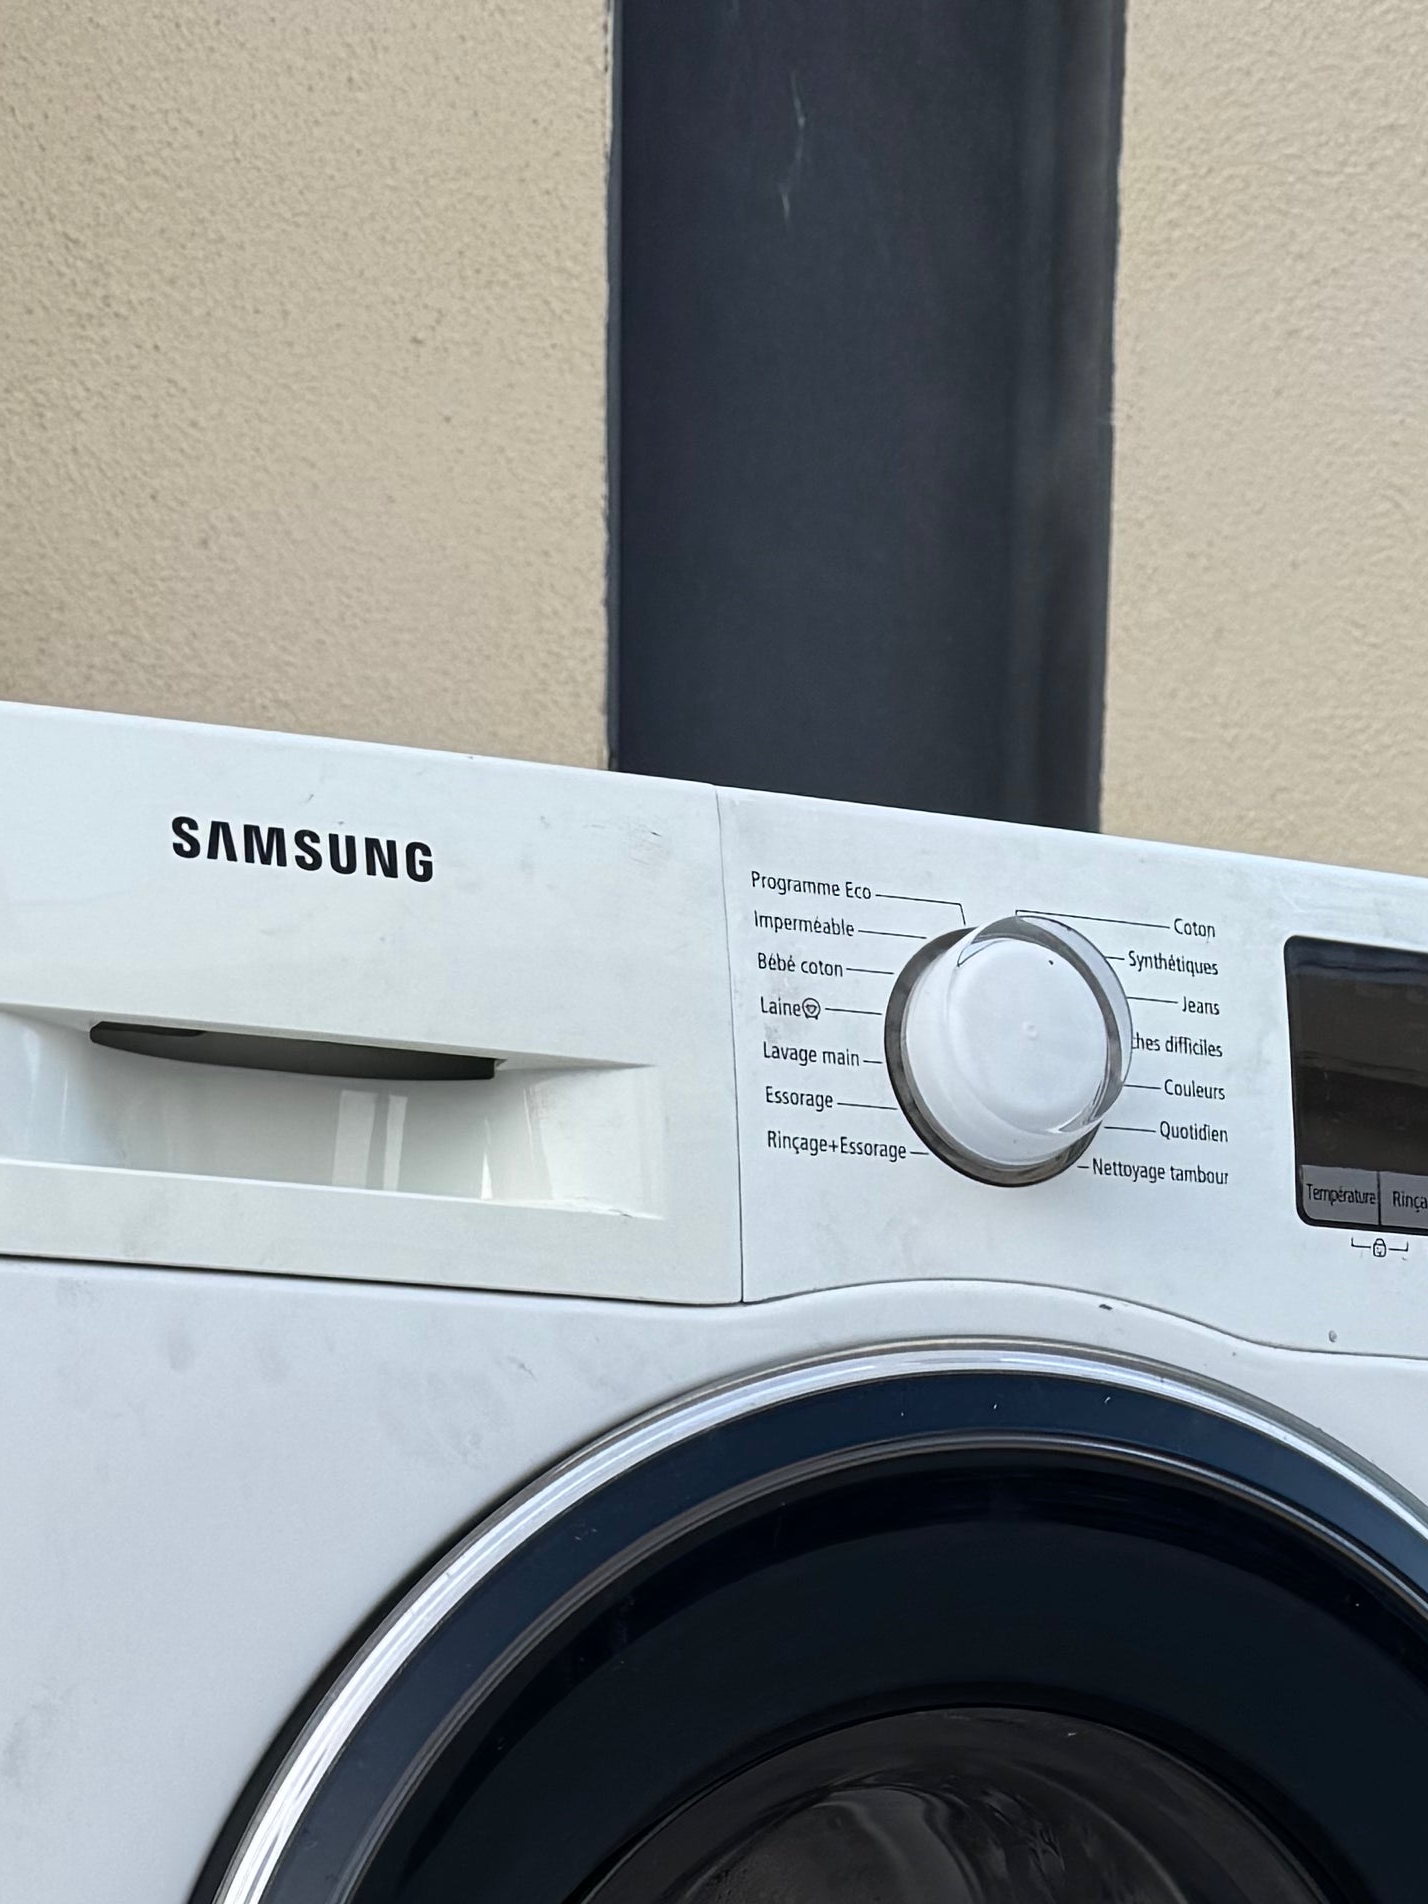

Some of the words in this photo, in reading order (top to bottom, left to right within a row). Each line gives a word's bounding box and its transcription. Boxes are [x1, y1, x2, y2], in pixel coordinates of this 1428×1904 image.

[172, 815, 434, 883] SAMSUNG
[751, 871, 841, 899] Programme
[845, 881, 872, 900] Eco
[754, 911, 854, 938] Imperméable
[1174, 919, 1215, 940] Coton
[757, 952, 796, 974] Bébé
[802, 959, 843, 978] coton
[1128, 950, 1219, 976] Synthétiques
[760, 997, 802, 1017] Laine
[1182, 997, 1220, 1016] Jeans
[763, 1042, 817, 1066] Lavage
[822, 1049, 860, 1067] main
[1166, 1036, 1223, 1057] difficiles
[766, 1087, 834, 1111] Essorage
[1164, 1079, 1226, 1100] Couleurs
[1159, 1122, 1228, 1143] Quotidien
[767, 1130, 907, 1162] Rinçage+Essorage
[1093, 1158, 1166, 1182] Nettoyage
[1170, 1166, 1228, 1185] tambour
[1307, 1183, 1377, 1208] Température
